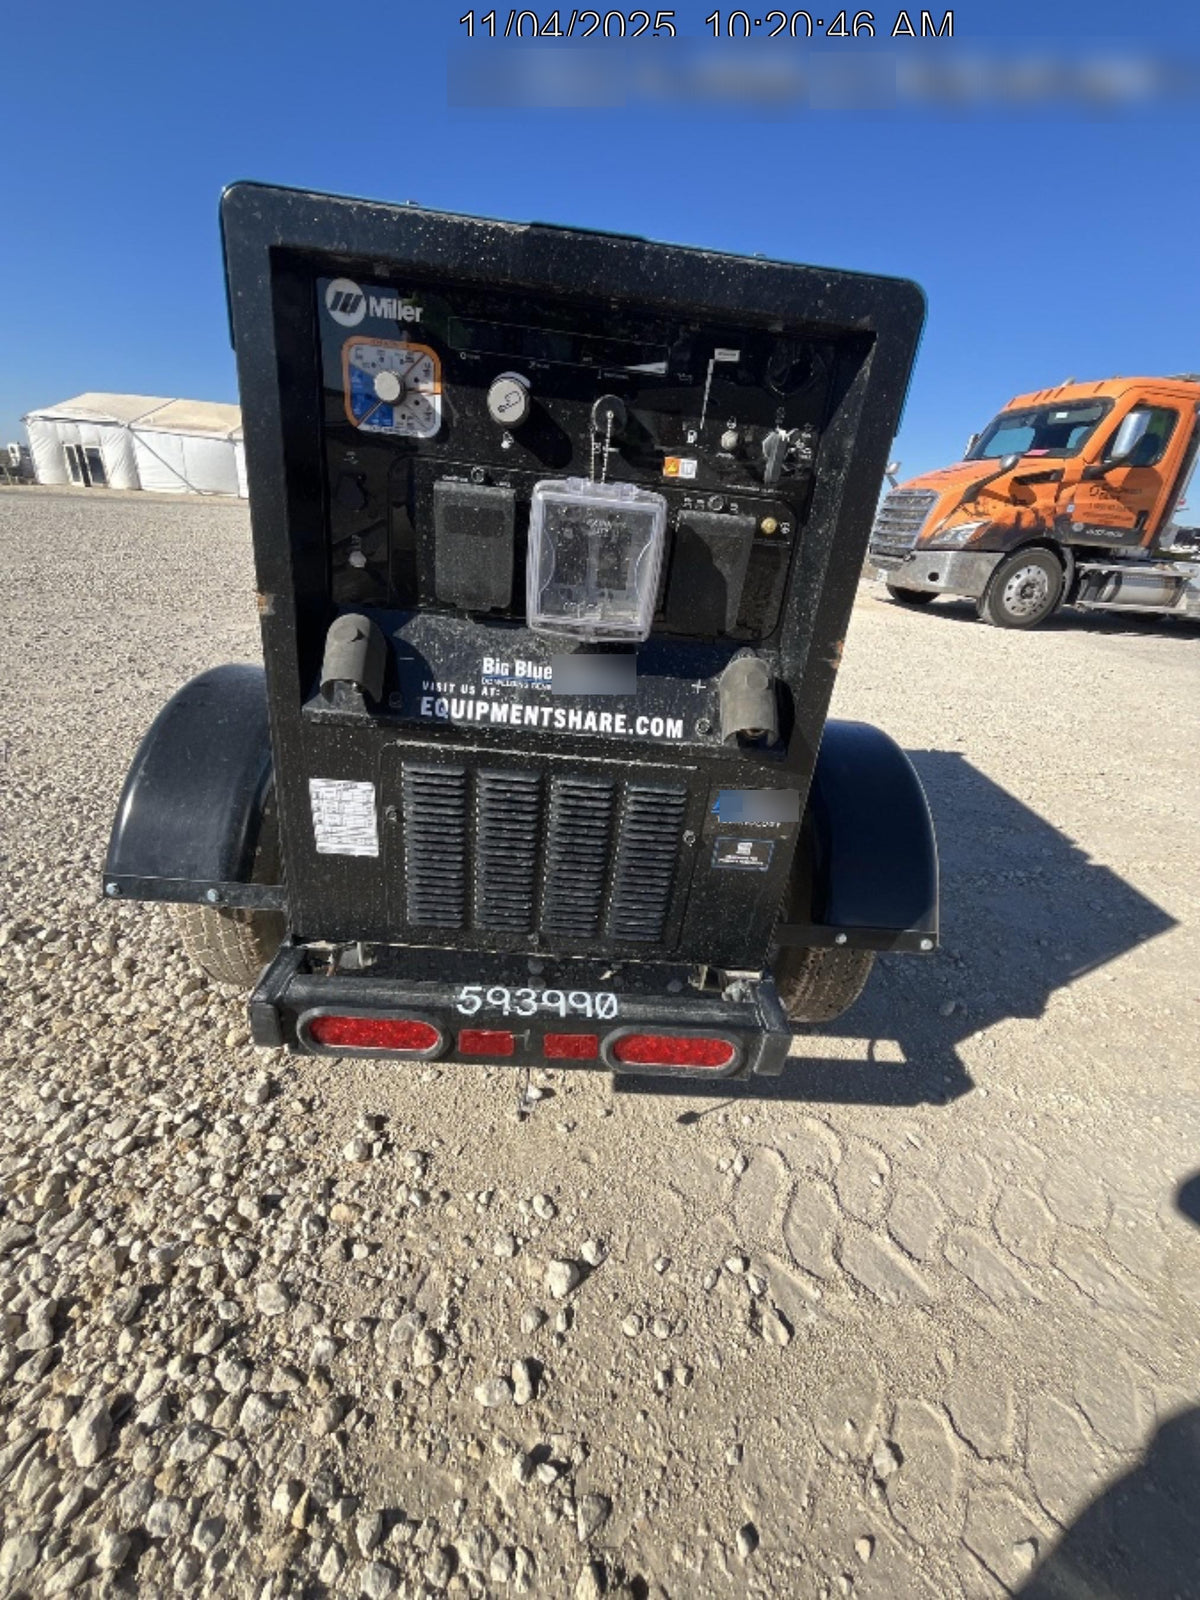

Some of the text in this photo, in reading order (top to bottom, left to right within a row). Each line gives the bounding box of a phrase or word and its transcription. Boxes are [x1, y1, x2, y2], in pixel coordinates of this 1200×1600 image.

[369, 295, 424, 323] Miller
[514, 659, 553, 680] Blue
[422, 680, 456, 693] VISIT
[461, 683, 476, 695] US
[481, 686, 500, 697] AT:
[420, 696, 684, 739] EQUIPMENTSHARE.COM
[456, 986, 618, 1019] 593990
